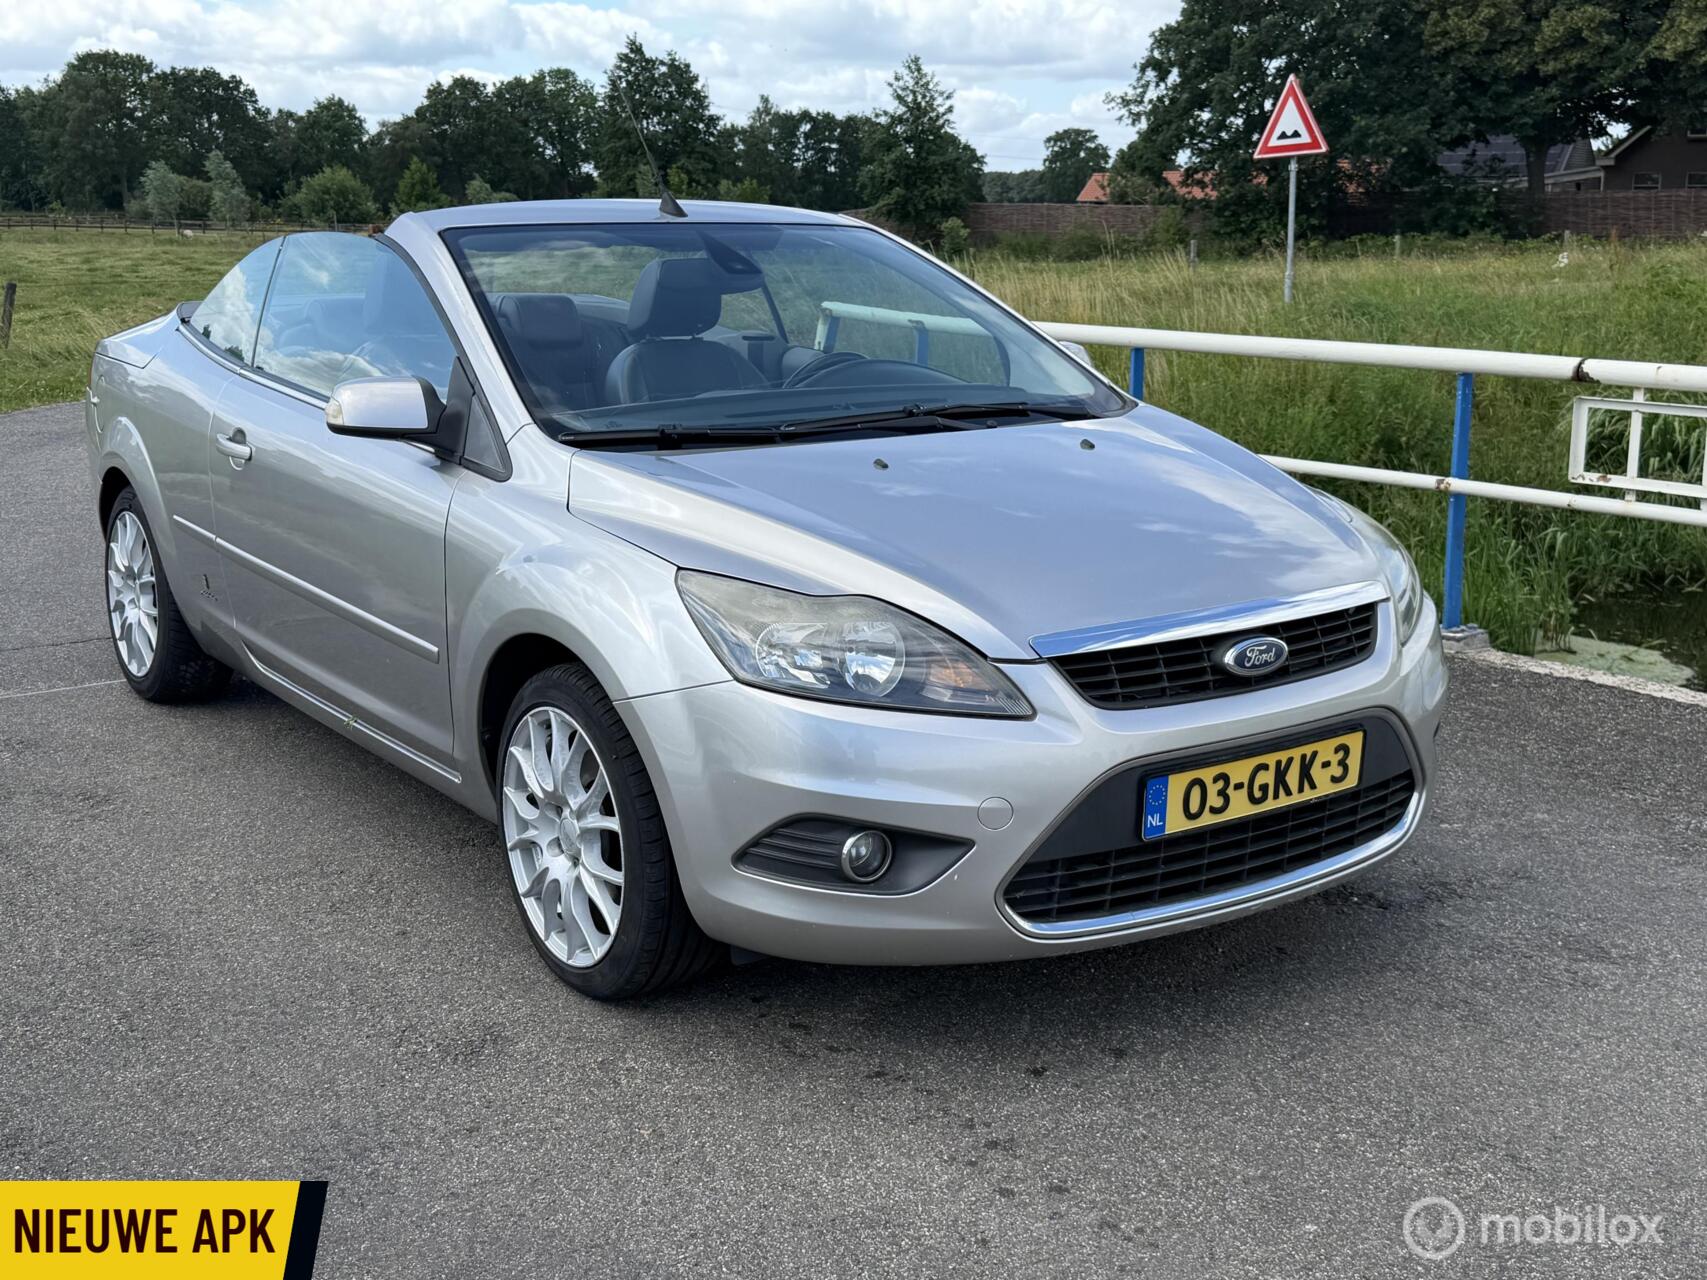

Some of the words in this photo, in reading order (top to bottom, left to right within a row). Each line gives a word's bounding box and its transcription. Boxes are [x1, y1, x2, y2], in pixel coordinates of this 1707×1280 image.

[1244, 645, 1276, 667] Ford
[1182, 742, 1351, 821] 03-GKK-3
[1147, 813, 1163, 828] NL
